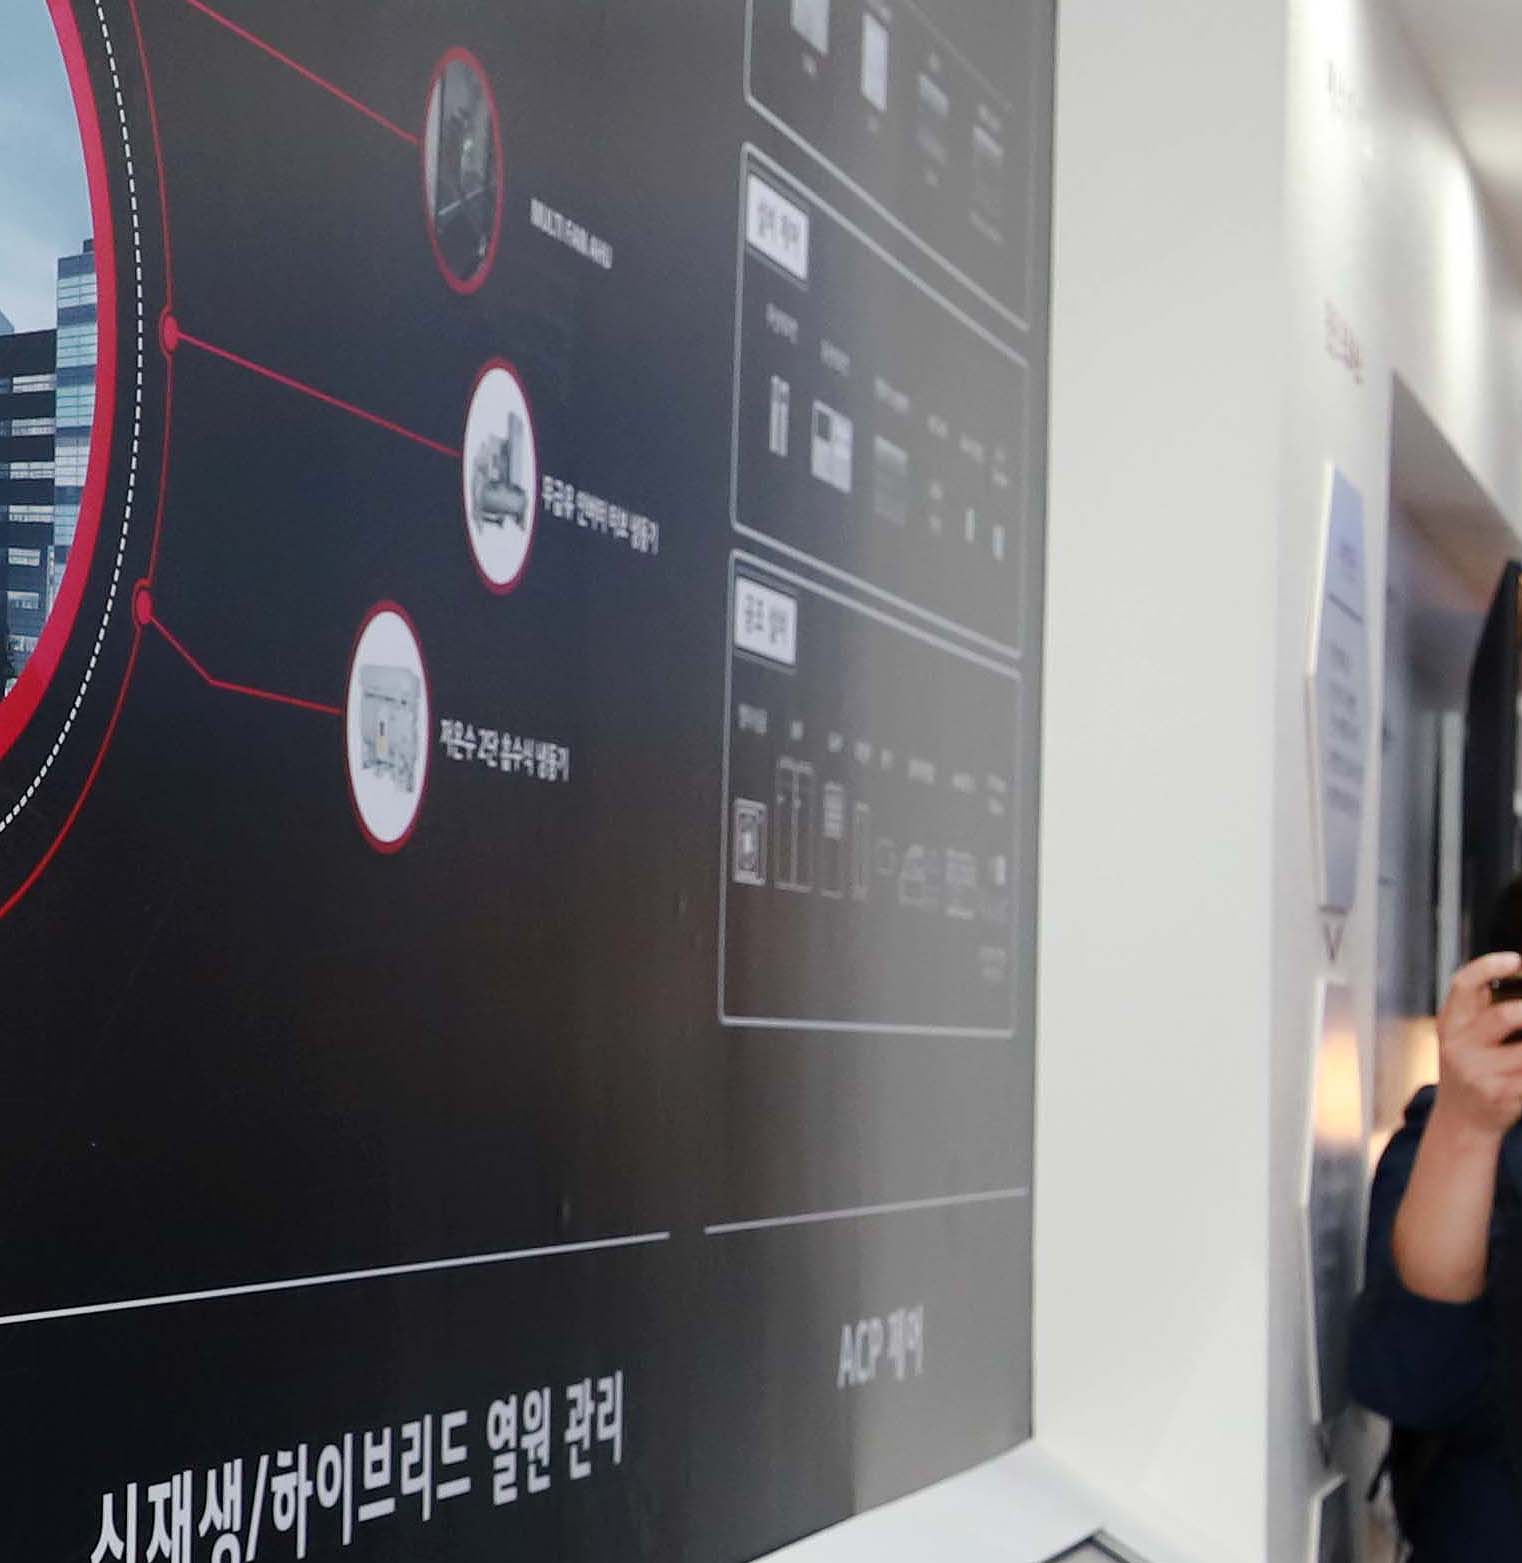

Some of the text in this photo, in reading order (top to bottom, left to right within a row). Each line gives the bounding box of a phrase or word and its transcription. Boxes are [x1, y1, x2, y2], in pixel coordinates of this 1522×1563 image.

[836, 1317, 884, 1389] ACP
[485, 1385, 552, 1507] 열원
[564, 1369, 625, 1478] 관리
